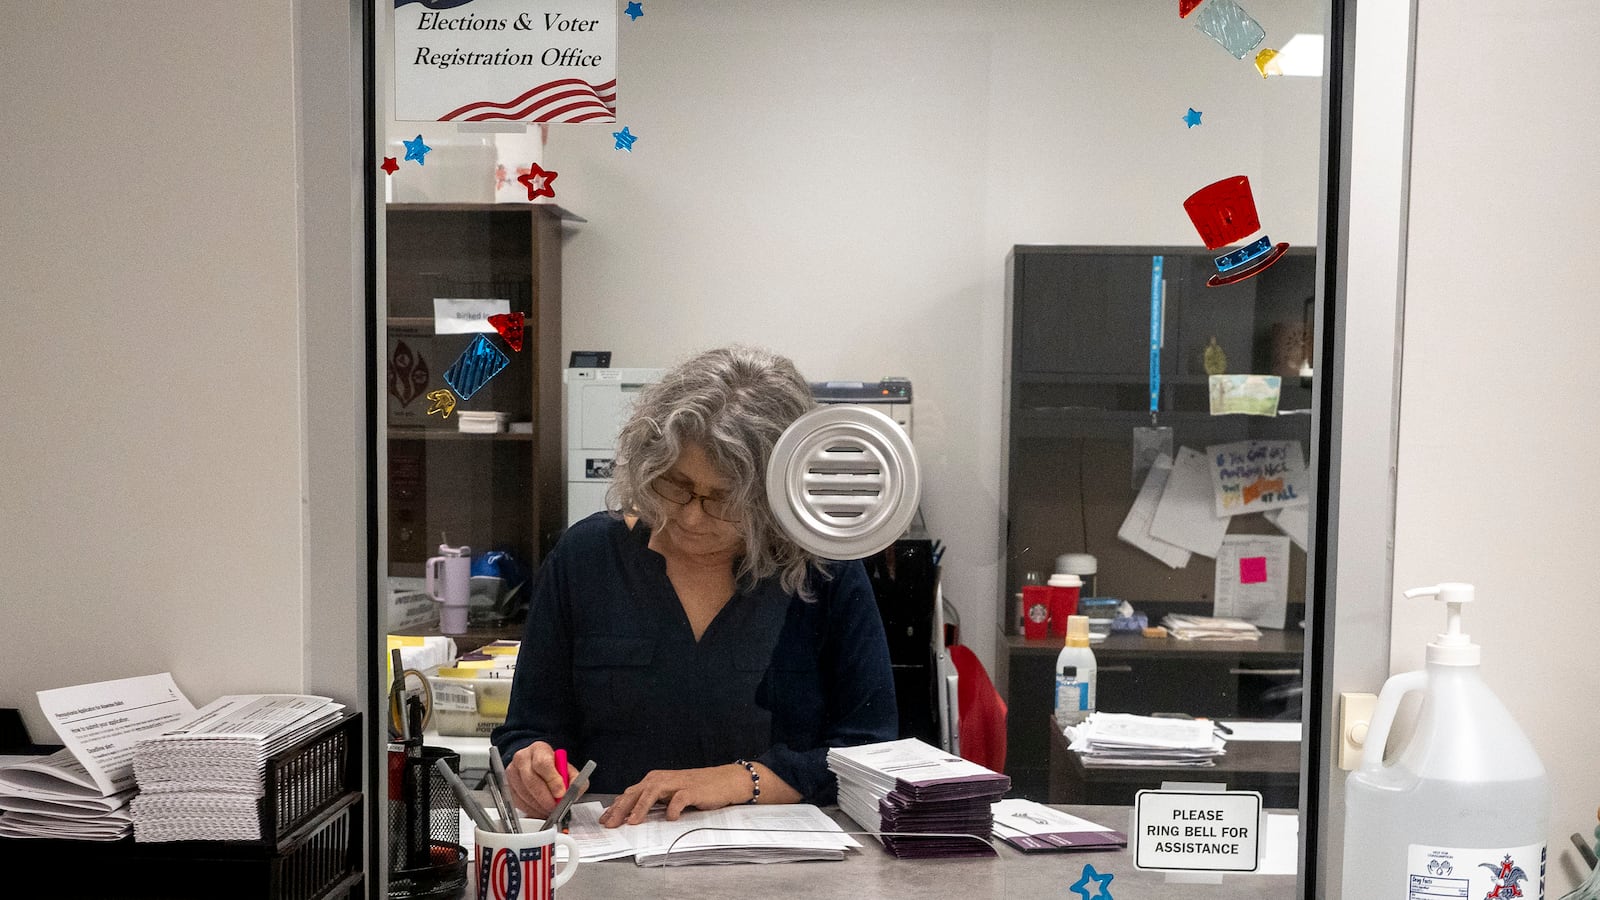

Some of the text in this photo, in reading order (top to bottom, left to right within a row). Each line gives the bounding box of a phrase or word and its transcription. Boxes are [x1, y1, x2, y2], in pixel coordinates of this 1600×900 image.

[416, 11, 599, 32] Elections & Voter
[413, 47, 602, 69] Registration Office
[1277, 484, 1298, 500] ALL
[1173, 809, 1224, 821] PLEASE
[1147, 825, 1248, 838] RING BELL FOR
[1155, 842, 1239, 854] ASSISTANCE
